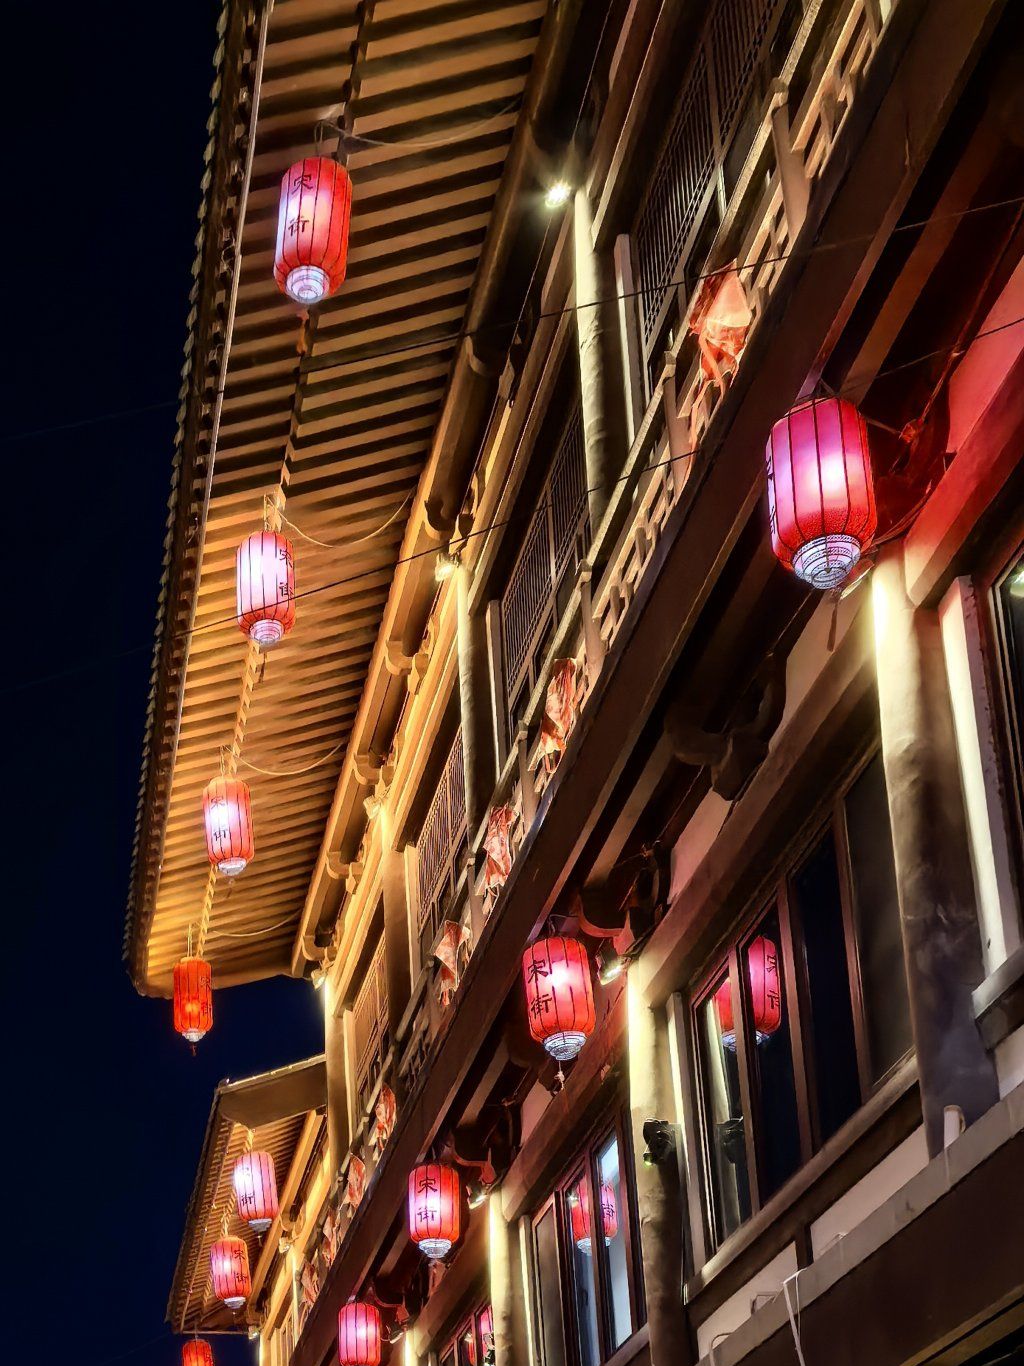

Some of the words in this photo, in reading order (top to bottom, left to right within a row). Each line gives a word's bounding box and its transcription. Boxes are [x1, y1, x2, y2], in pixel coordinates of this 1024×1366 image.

[528, 959, 552, 1020] 宋街
[417, 1177, 439, 1223] 宋街
[233, 1248, 249, 1285] 宋街
